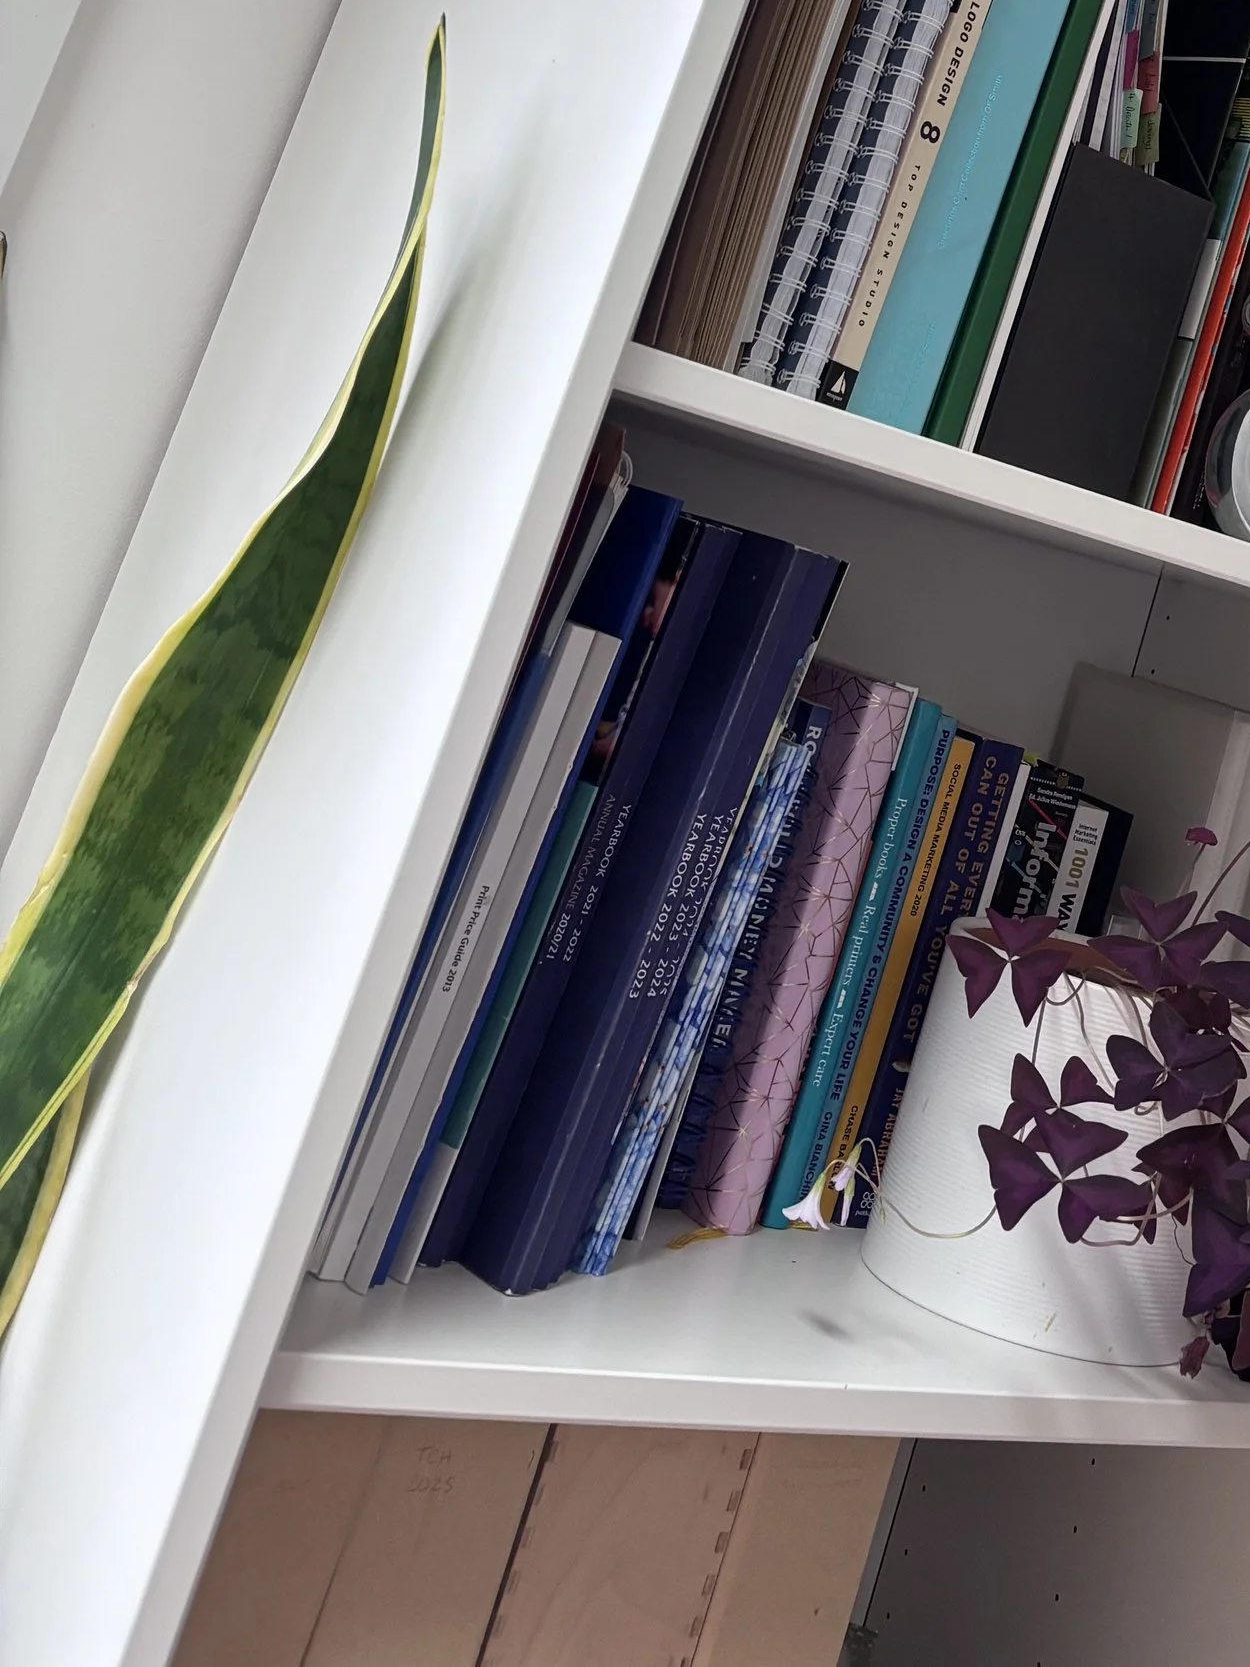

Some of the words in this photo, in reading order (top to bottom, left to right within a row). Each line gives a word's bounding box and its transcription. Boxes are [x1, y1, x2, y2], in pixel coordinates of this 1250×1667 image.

[960, 1, 979, 42] LOGO
[937, 46, 963, 105] DESIGN
[920, 121, 940, 143] 8
[973, 114, 987, 135] from
[908, 165, 920, 191] TOP
[883, 201, 907, 258] DESIGN
[859, 269, 882, 326] STUDIO
[923, 729, 949, 794] PURPOSE:
[945, 763, 960, 798] SOCIAL
[977, 756, 996, 794] CAN
[591, 794, 615, 842] ANNUAL
[886, 796, 907, 839] Proper
[907, 798, 928, 849] DESIGN
[935, 801, 949, 831] MEDIA
[965, 802, 982, 840] OUT
[977, 773, 1008, 853] GETTING
[596, 805, 631, 876] YEARBOOK
[667, 814, 706, 897] YEARBOOK
[684, 815, 723, 897] YEARBOOK
[903, 852, 911, 861] A
[565, 846, 595, 909] MAGAZINE
[875, 842, 894, 878] books
[917, 834, 939, 891] MARKETING
[956, 848, 968, 873] OF
[1068, 847, 1088, 887] 1001
[474, 885, 489, 908] Print
[581, 885, 597, 913] 2021
[910, 894, 921, 915] 2020
[941, 880, 959, 914] ALL
[960, 861, 983, 915] EVER
[464, 911, 479, 935] Price
[650, 903, 671, 941] 2022
[669, 903, 689, 940] 2023
[858, 905, 875, 933] Real
[877, 866, 907, 952] COMMUNITY
[451, 937, 468, 966] Guide
[546, 913, 570, 958] 2020/21
[563, 928, 580, 961] 2022
[629, 959, 650, 997] 2023
[647, 958, 668, 996] 2024
[839, 935, 863, 985] printers
[917, 925, 946, 995] YOU'VE
[442, 969, 456, 991] 2013
[853, 967, 877, 1027] CHANGE
[821, 1013, 843, 1054] Expert
[904, 1004, 922, 1042] GOT
[840, 1031, 858, 1069] YOUR
[812, 1059, 826, 1086] care
[831, 1073, 845, 1099] LIFE
[891, 1088, 904, 1109] JAY
[818, 1111, 832, 1140] GINA
[843, 1105, 859, 1141] CHASE
